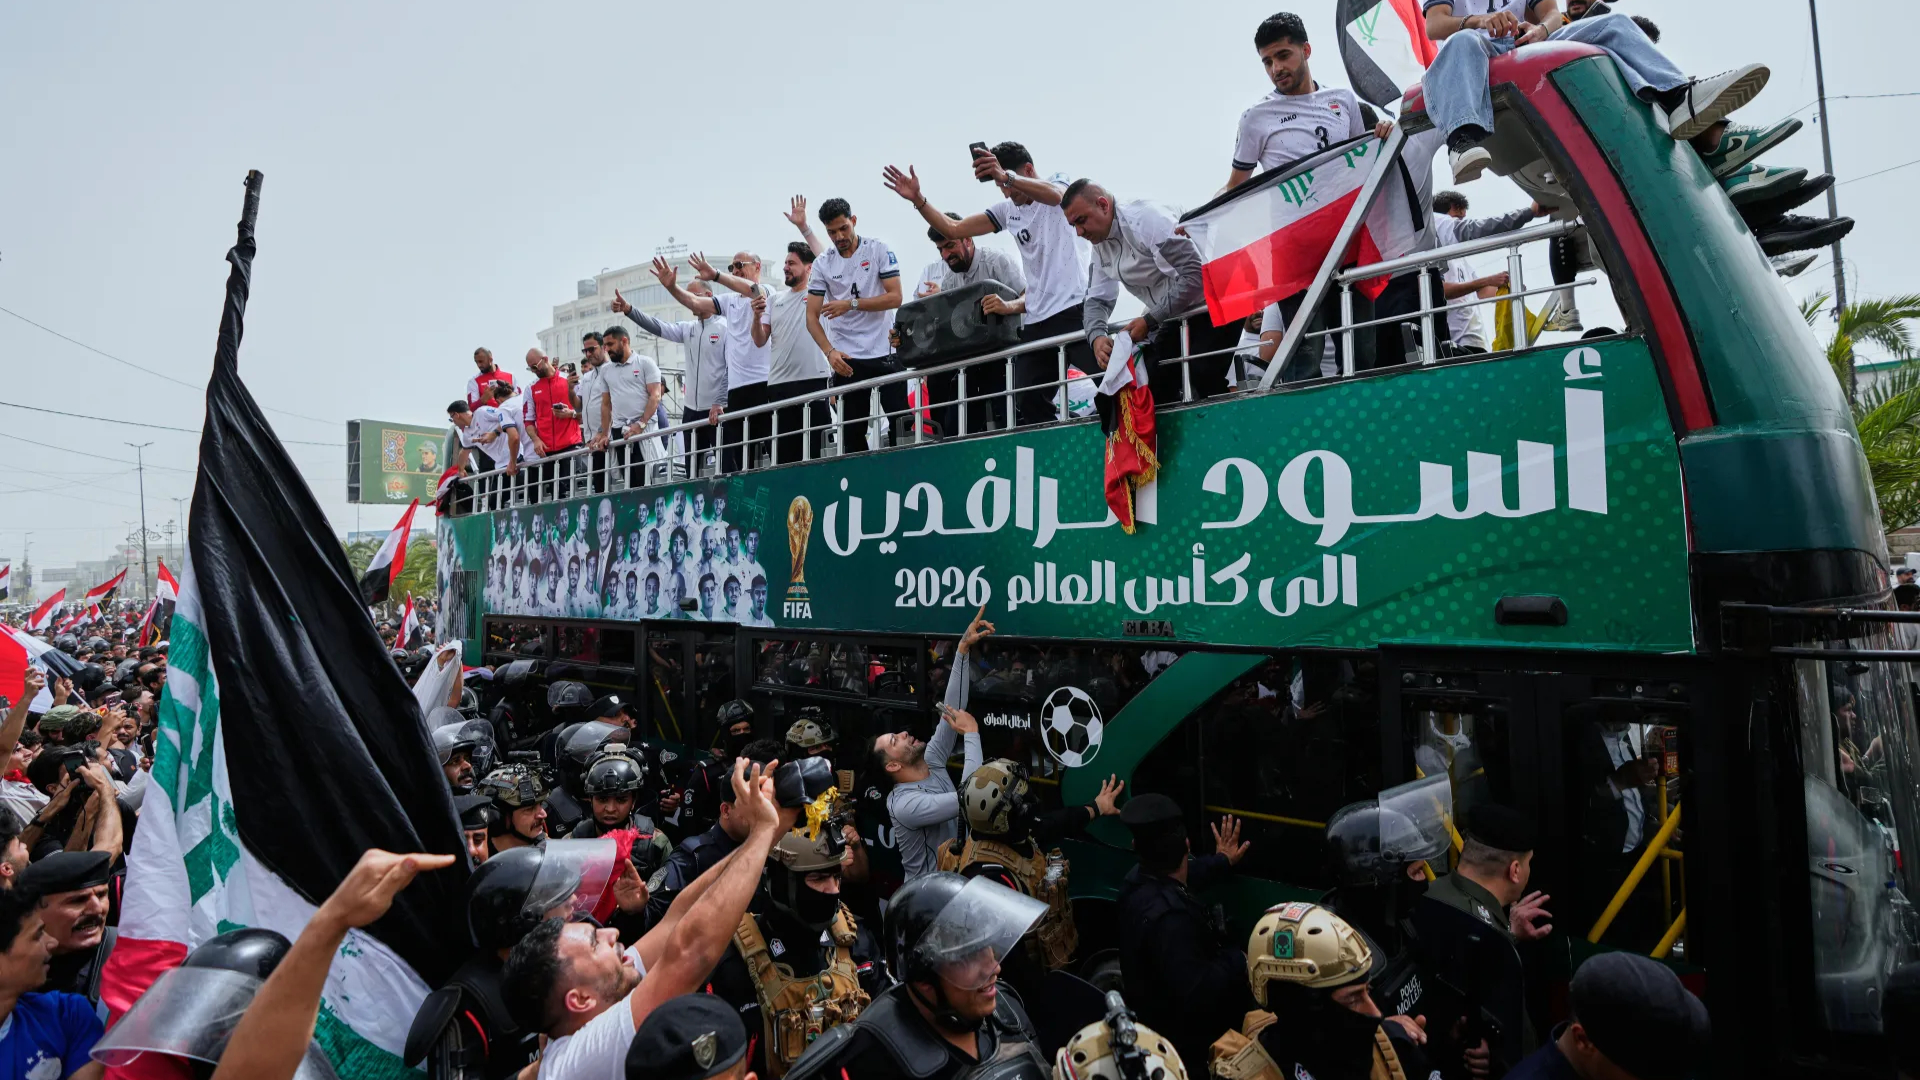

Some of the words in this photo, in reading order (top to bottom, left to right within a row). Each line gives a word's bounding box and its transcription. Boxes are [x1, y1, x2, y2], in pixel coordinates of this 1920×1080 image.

[1280, 114, 1297, 124] JAKO
[1314, 126, 1329, 149] 3
[850, 282, 860, 298] 4
[1201, 346, 1608, 547] أسود
[895, 565, 991, 607] 2026
[1007, 560, 1116, 613] العالم
[1123, 542, 1251, 614] كأس
[783, 601, 812, 619] FIFA
[1121, 620, 1176, 637] ELBA
[983, 712, 1008, 727] العراق
[1007, 712, 1031, 731] أبطال
[1400, 974, 1419, 1001] POLICE
